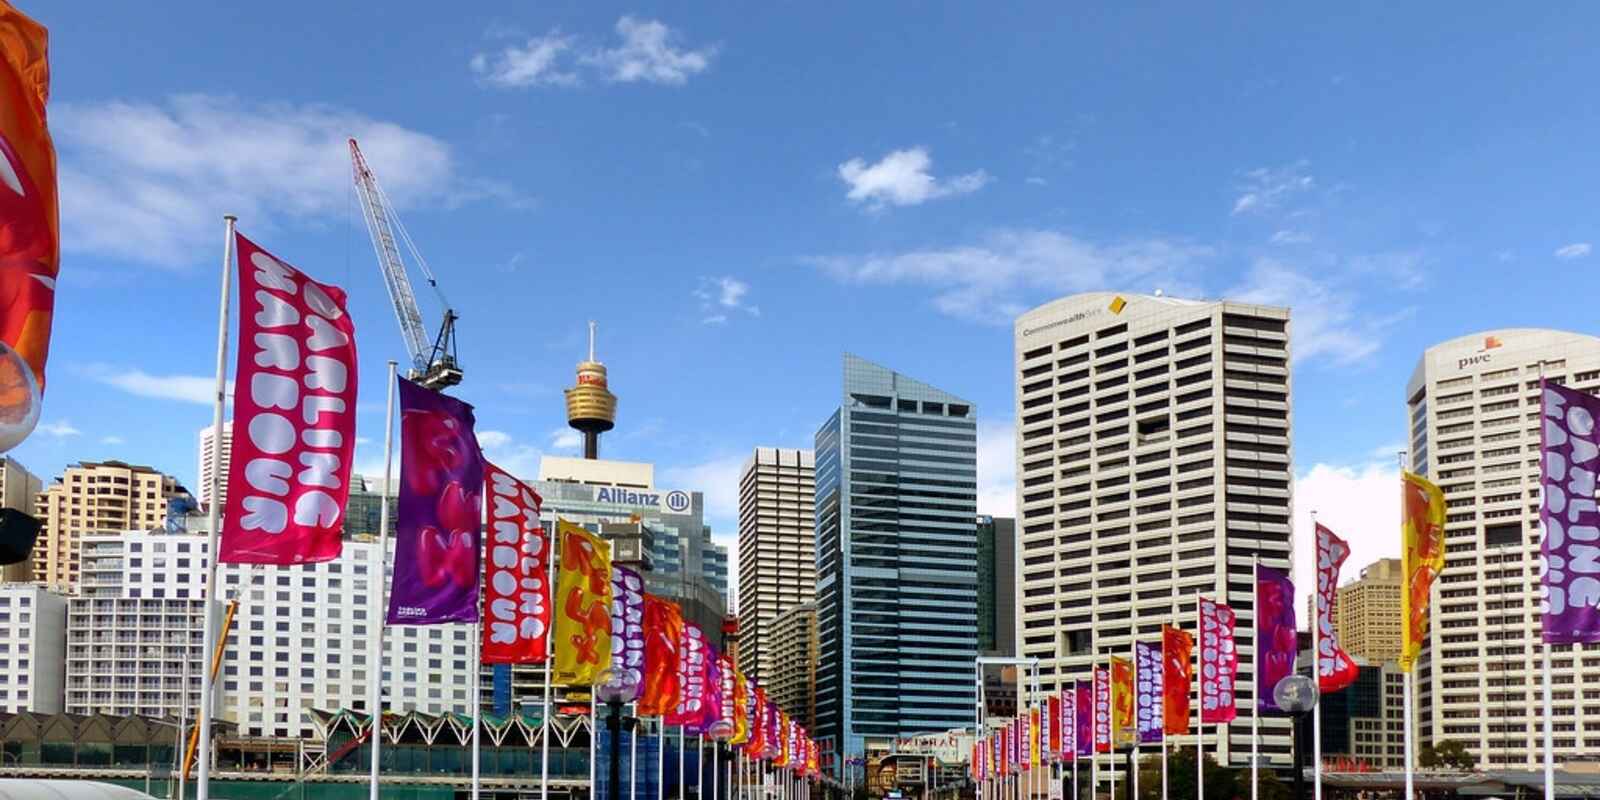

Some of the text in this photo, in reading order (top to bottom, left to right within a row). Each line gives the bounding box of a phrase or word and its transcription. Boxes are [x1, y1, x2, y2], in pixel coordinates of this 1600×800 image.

[239, 251, 300, 535] HARBOUR
[293, 281, 349, 529] DARLING
[1458, 354, 1491, 370] pwc
[597, 488, 660, 506] Allianz
[1566, 405, 1600, 608] DARLING
[490, 471, 520, 645] HARBOUR
[519, 487, 544, 640] DARLING
[624, 575, 644, 686] DARLING
[687, 625, 704, 712] DARLING
[1201, 601, 1218, 710] HARBOUR
[1217, 608, 1235, 707] DARLING
[1096, 670, 1110, 744] HARBOUR
[1137, 643, 1152, 733] HARBOUR
